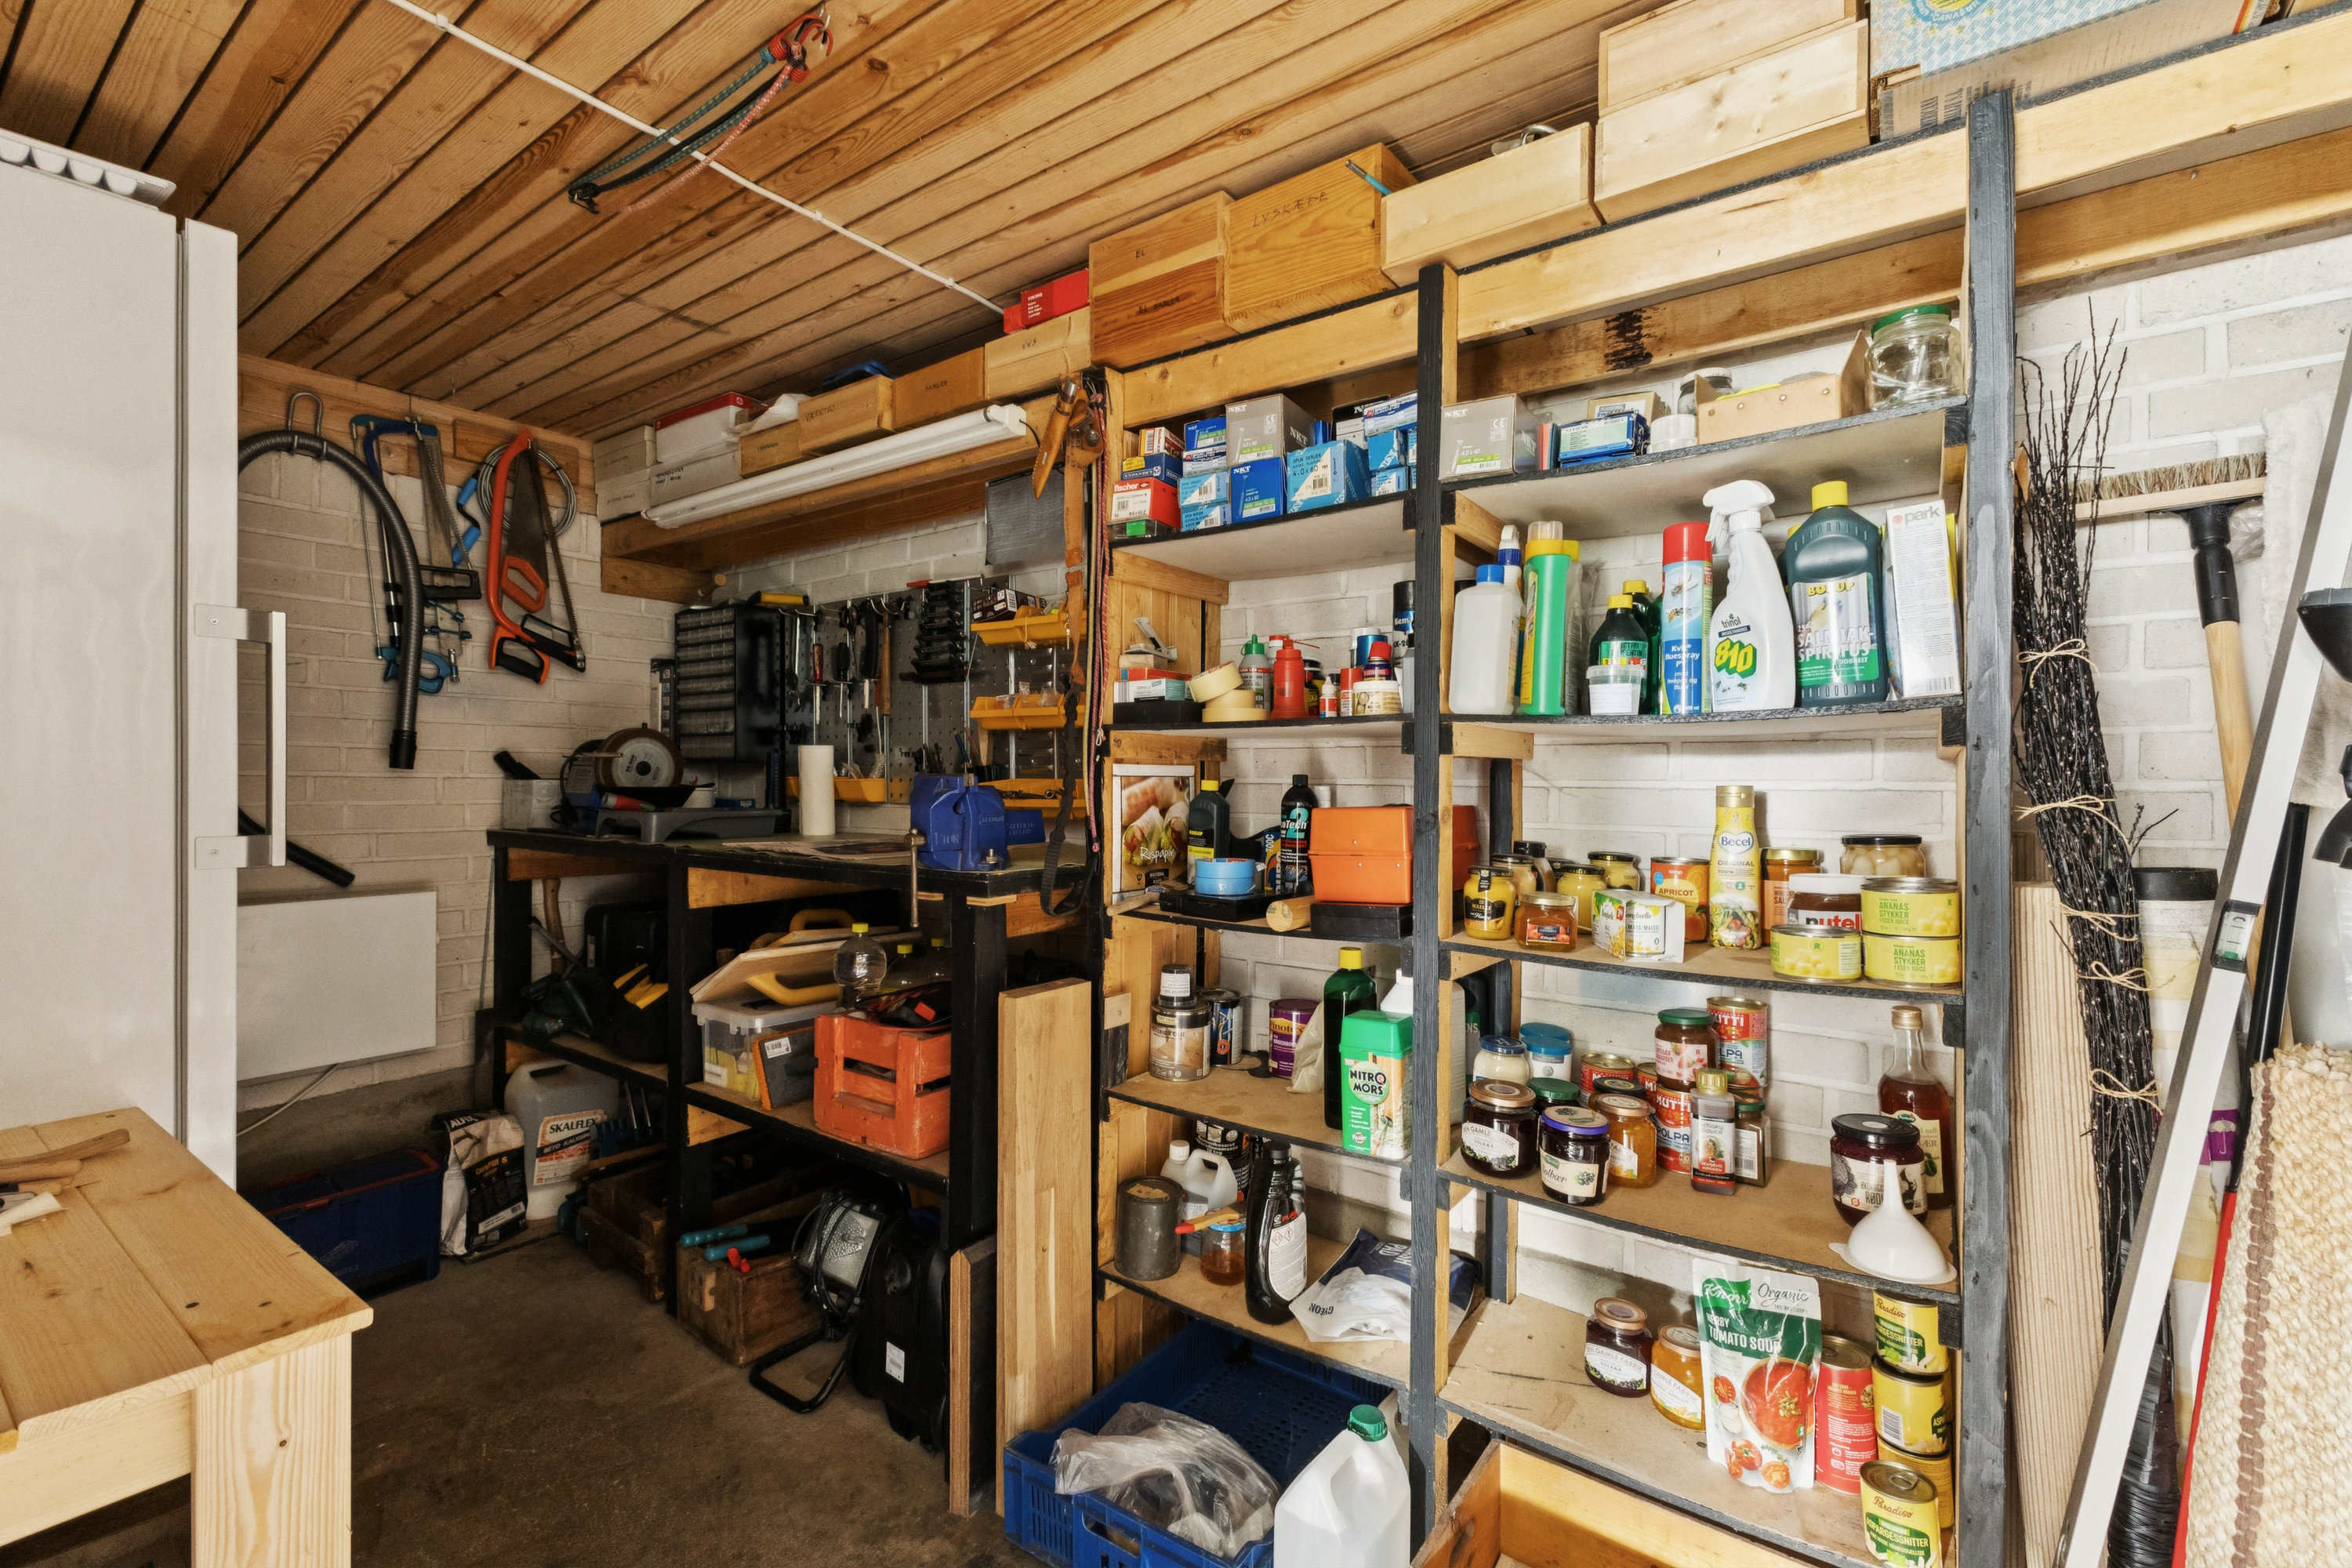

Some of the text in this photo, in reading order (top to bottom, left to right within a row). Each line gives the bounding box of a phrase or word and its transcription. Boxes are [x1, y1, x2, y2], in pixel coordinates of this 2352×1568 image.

[1252, 191, 1330, 228] LYSKÆDE
[1135, 249, 1146, 259] EL
[1022, 338, 1038, 350] VVS
[1229, 405, 1247, 413] NKT
[1444, 408, 1468, 418] NKT
[1290, 426, 1308, 445] NKT
[1114, 482, 1138, 492] fischer
[1904, 506, 1940, 524] park
[1807, 581, 1855, 597] BOUP
[1721, 615, 1741, 628] trinol
[1715, 637, 1756, 678] 810
[1838, 656, 1868, 665] DOBBELT
[1286, 807, 1308, 839] 2
[1265, 833, 1274, 853] 700C
[1721, 837, 1751, 847] Becel
[1139, 846, 1174, 864] Rispapir
[1879, 902, 1909, 910] ANANAS
[1806, 913, 1863, 931] nutel
[1879, 910, 1909, 919] STYKKER
[1893, 949, 1925, 958] ANANAS
[1893, 956, 1926, 965] STYKKER
[1715, 1014, 1744, 1027] UTTI
[1719, 1047, 1742, 1058] LPA
[1349, 1069, 1386, 1085] NITRO
[1353, 1083, 1383, 1095] MORS
[1656, 1094, 1690, 1112] MUTTI
[550, 1117, 597, 1134] SKALFLEX
[1470, 1127, 1491, 1137] GAMLE
[1656, 1128, 1690, 1143] POLPA
[1704, 1283, 1748, 1305] Knorr
[1758, 1283, 1809, 1307] Organic
[1876, 1298, 1906, 1319] Paradiso
[1708, 1325, 1782, 1355] TOMATO SOUP
[1875, 1323, 1923, 1347] PARGESSNITTER
[1595, 1348, 1619, 1361] GAMLE
[1619, 1356, 1643, 1372] FABRIK
